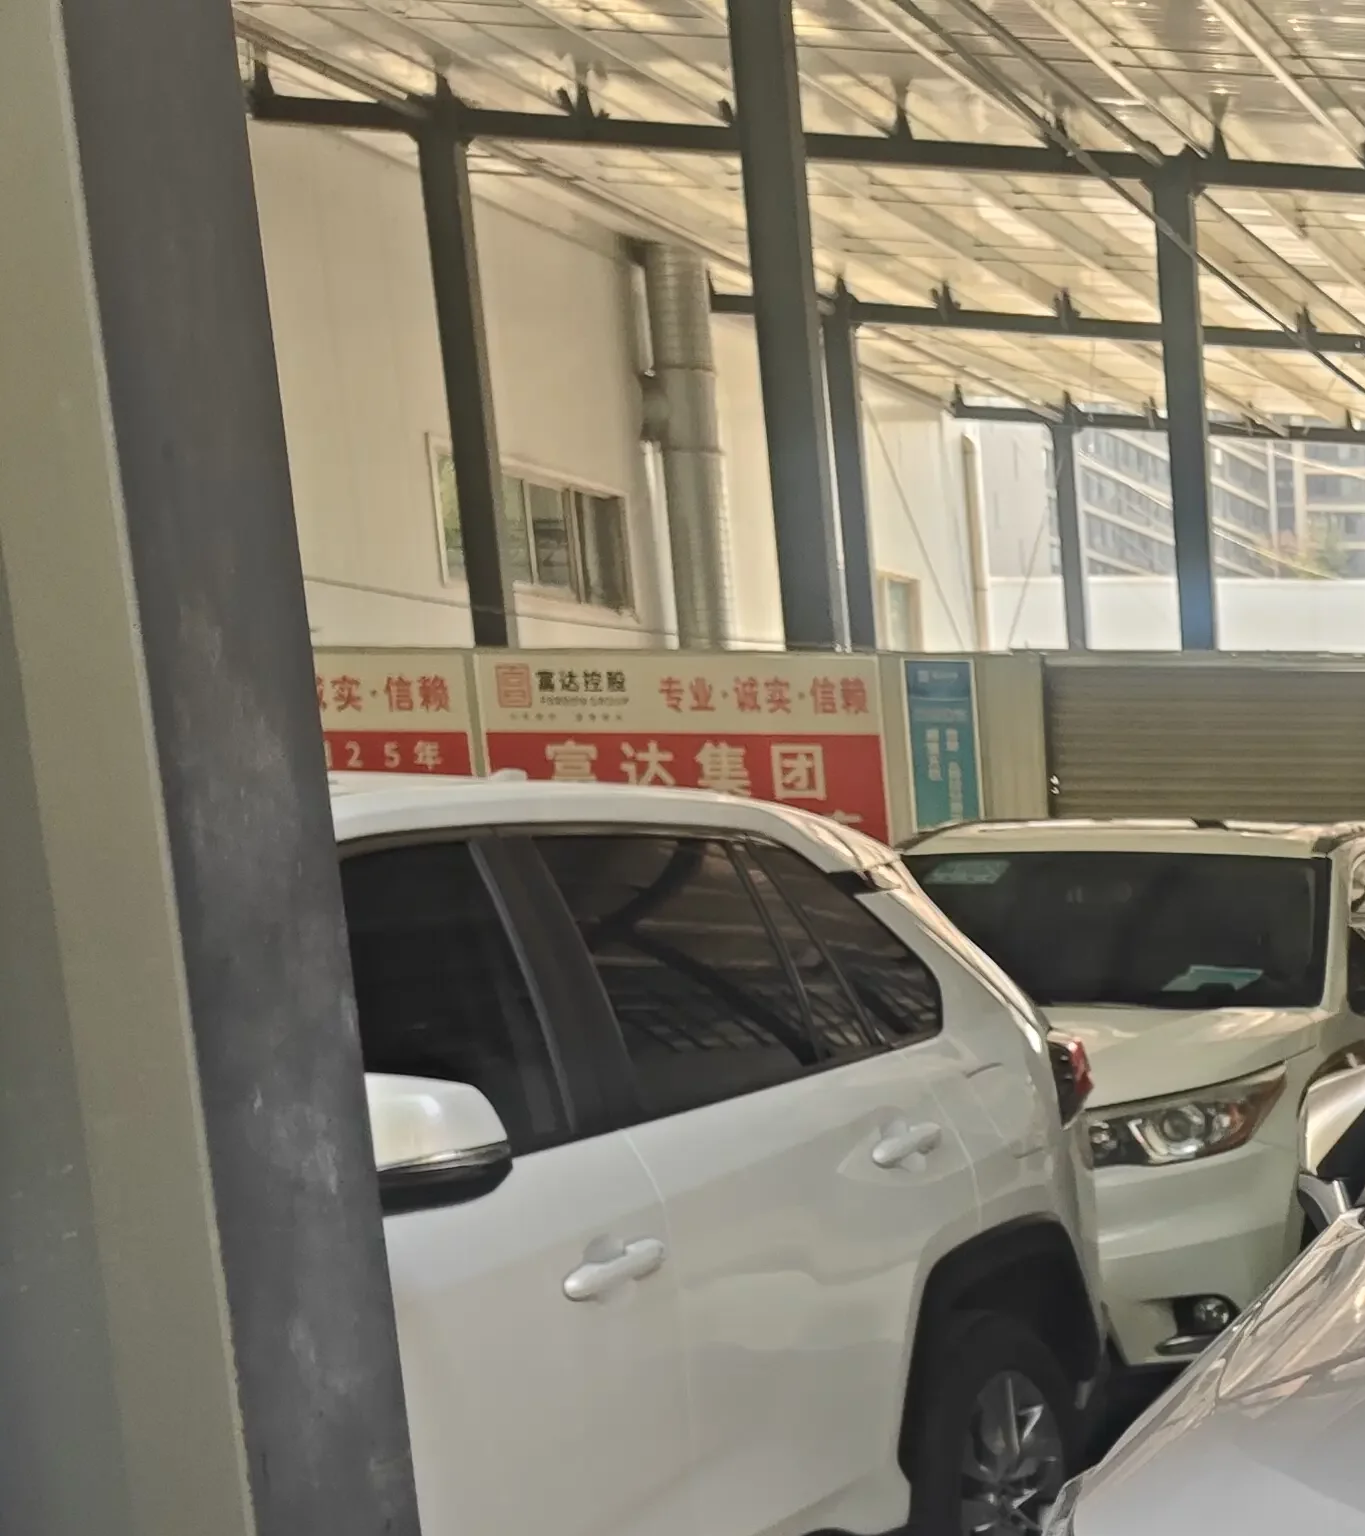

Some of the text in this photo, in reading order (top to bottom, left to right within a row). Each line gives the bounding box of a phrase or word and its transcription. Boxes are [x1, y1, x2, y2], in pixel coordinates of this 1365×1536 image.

[658, 676, 869, 715] 专业·诚实·信赖
[545, 736, 827, 801] 富达集团
